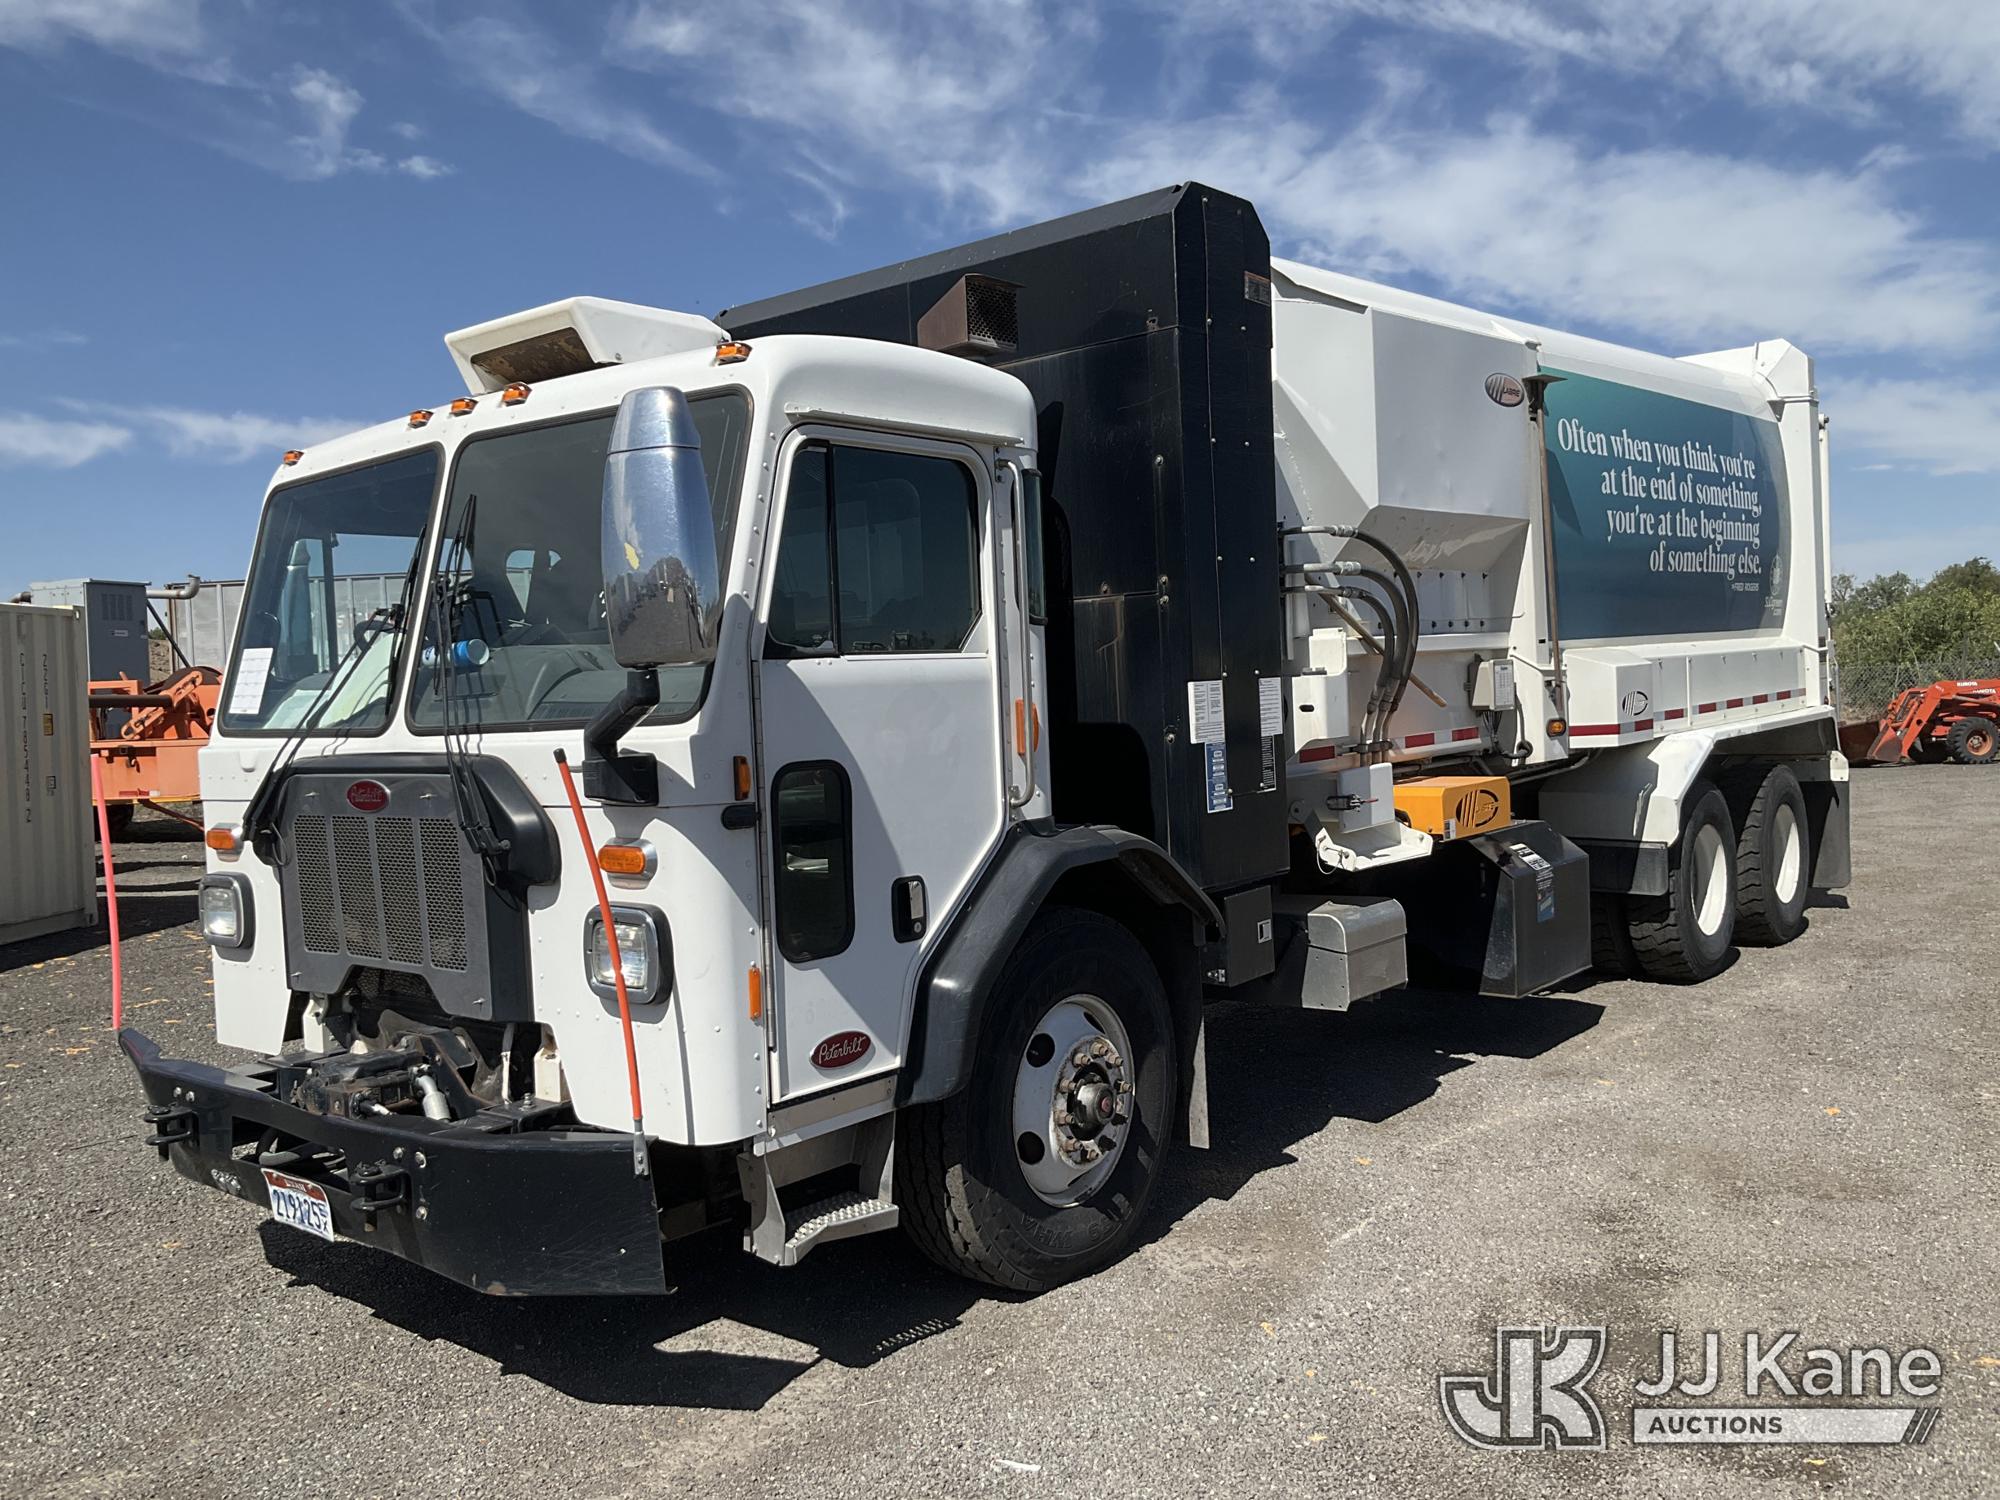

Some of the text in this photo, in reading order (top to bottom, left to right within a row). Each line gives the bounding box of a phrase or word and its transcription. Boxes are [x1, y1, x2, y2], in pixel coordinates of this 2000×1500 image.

[1557, 417, 1756, 483] Often when you think you're
[1601, 465, 1762, 518] at the end of something,
[1606, 504, 1760, 550] you're at the beginning
[1650, 540, 1666, 572] of
[1667, 543, 1736, 581] something
[1738, 546, 1762, 574] else.
[818, 1035, 867, 1065] Peterbilt
